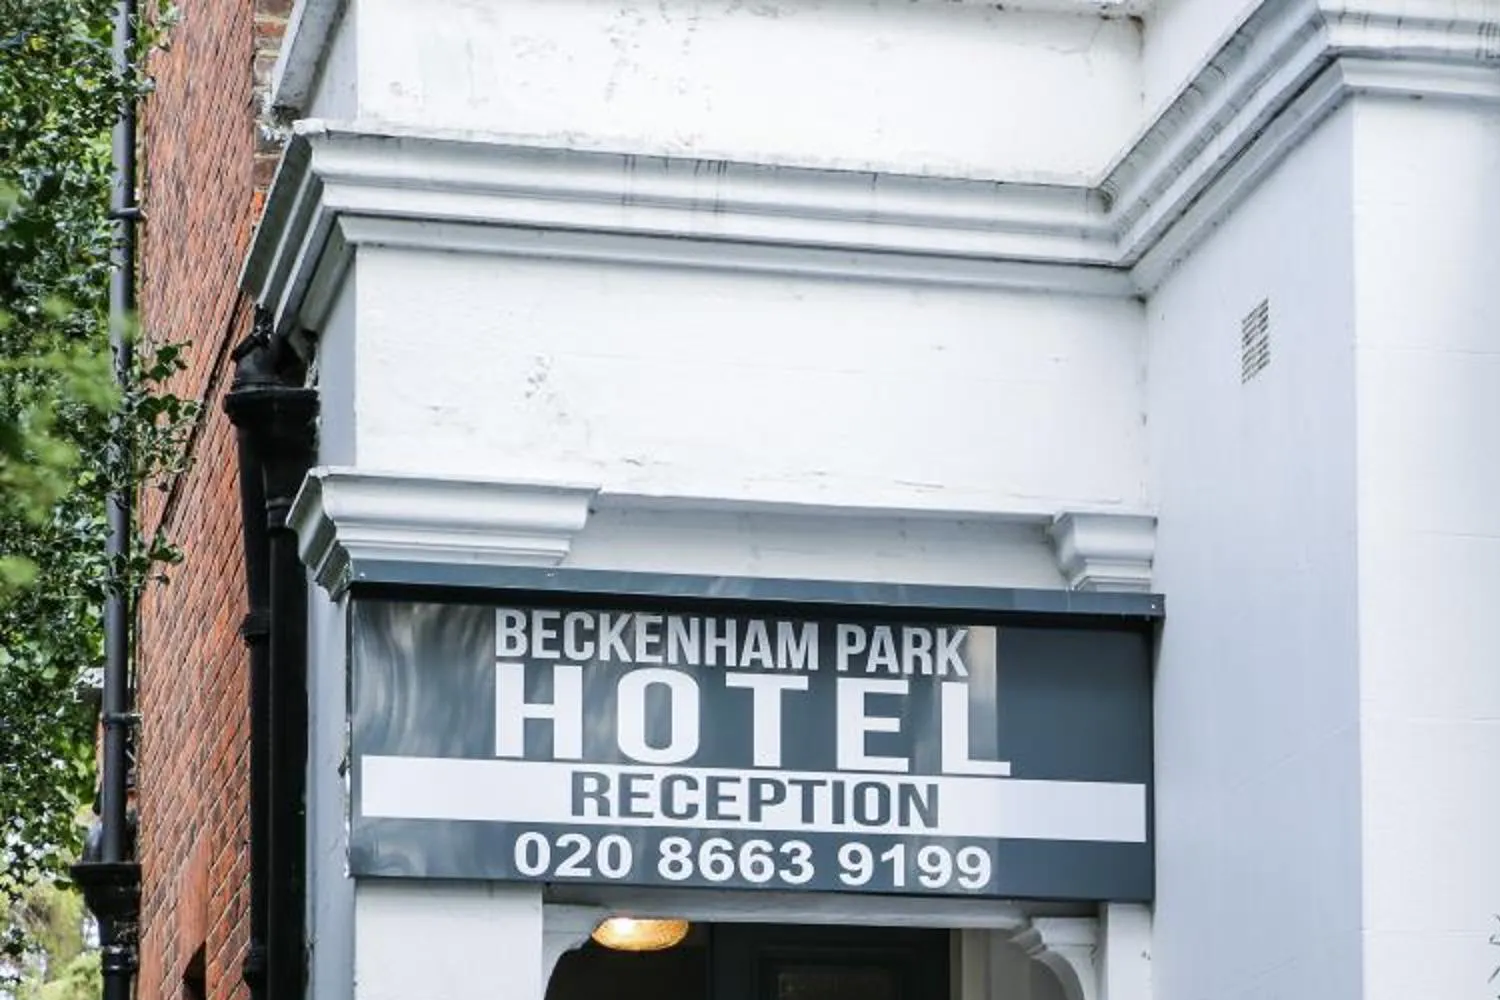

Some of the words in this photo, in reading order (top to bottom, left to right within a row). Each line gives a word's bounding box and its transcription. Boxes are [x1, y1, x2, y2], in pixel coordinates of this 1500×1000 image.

[494, 608, 819, 671] BECKENHAM
[837, 623, 969, 677] PARK
[494, 662, 1012, 776] HOTEL
[570, 770, 939, 829] RECEPTION
[514, 831, 633, 879] 020
[657, 835, 815, 885] 8663
[838, 841, 992, 890] 9199
